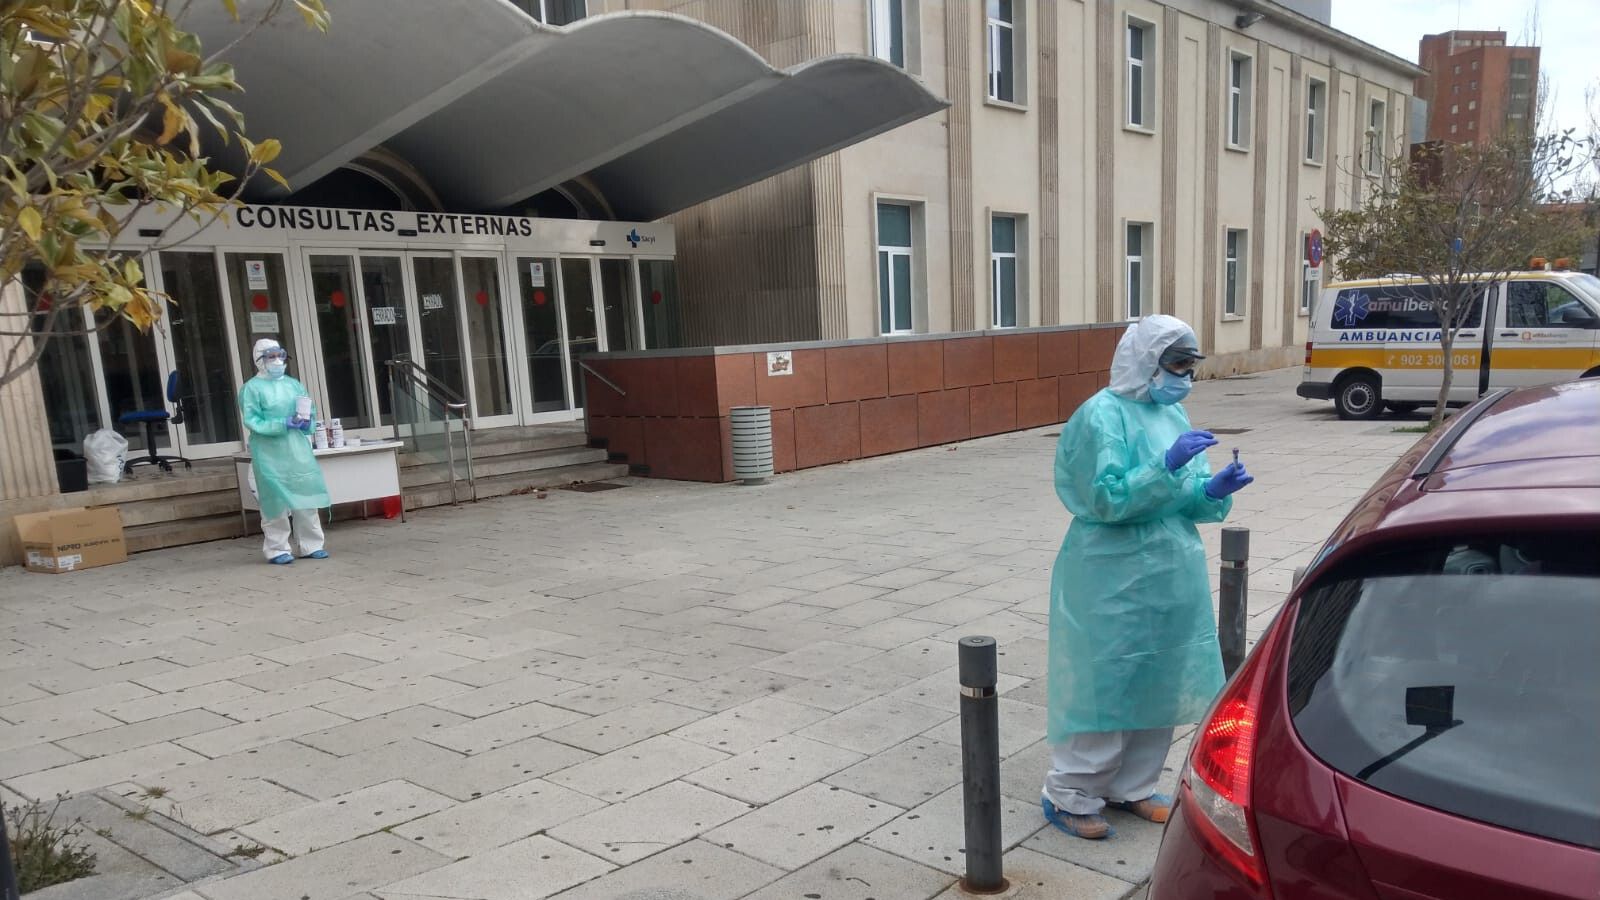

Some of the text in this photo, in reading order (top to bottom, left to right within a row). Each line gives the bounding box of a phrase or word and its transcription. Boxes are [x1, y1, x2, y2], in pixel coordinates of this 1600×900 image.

[236, 205, 532, 237] CONSULTAS EXTERNAS
[1401, 355, 1423, 366] 902
[1454, 354, 1476, 365] 061
